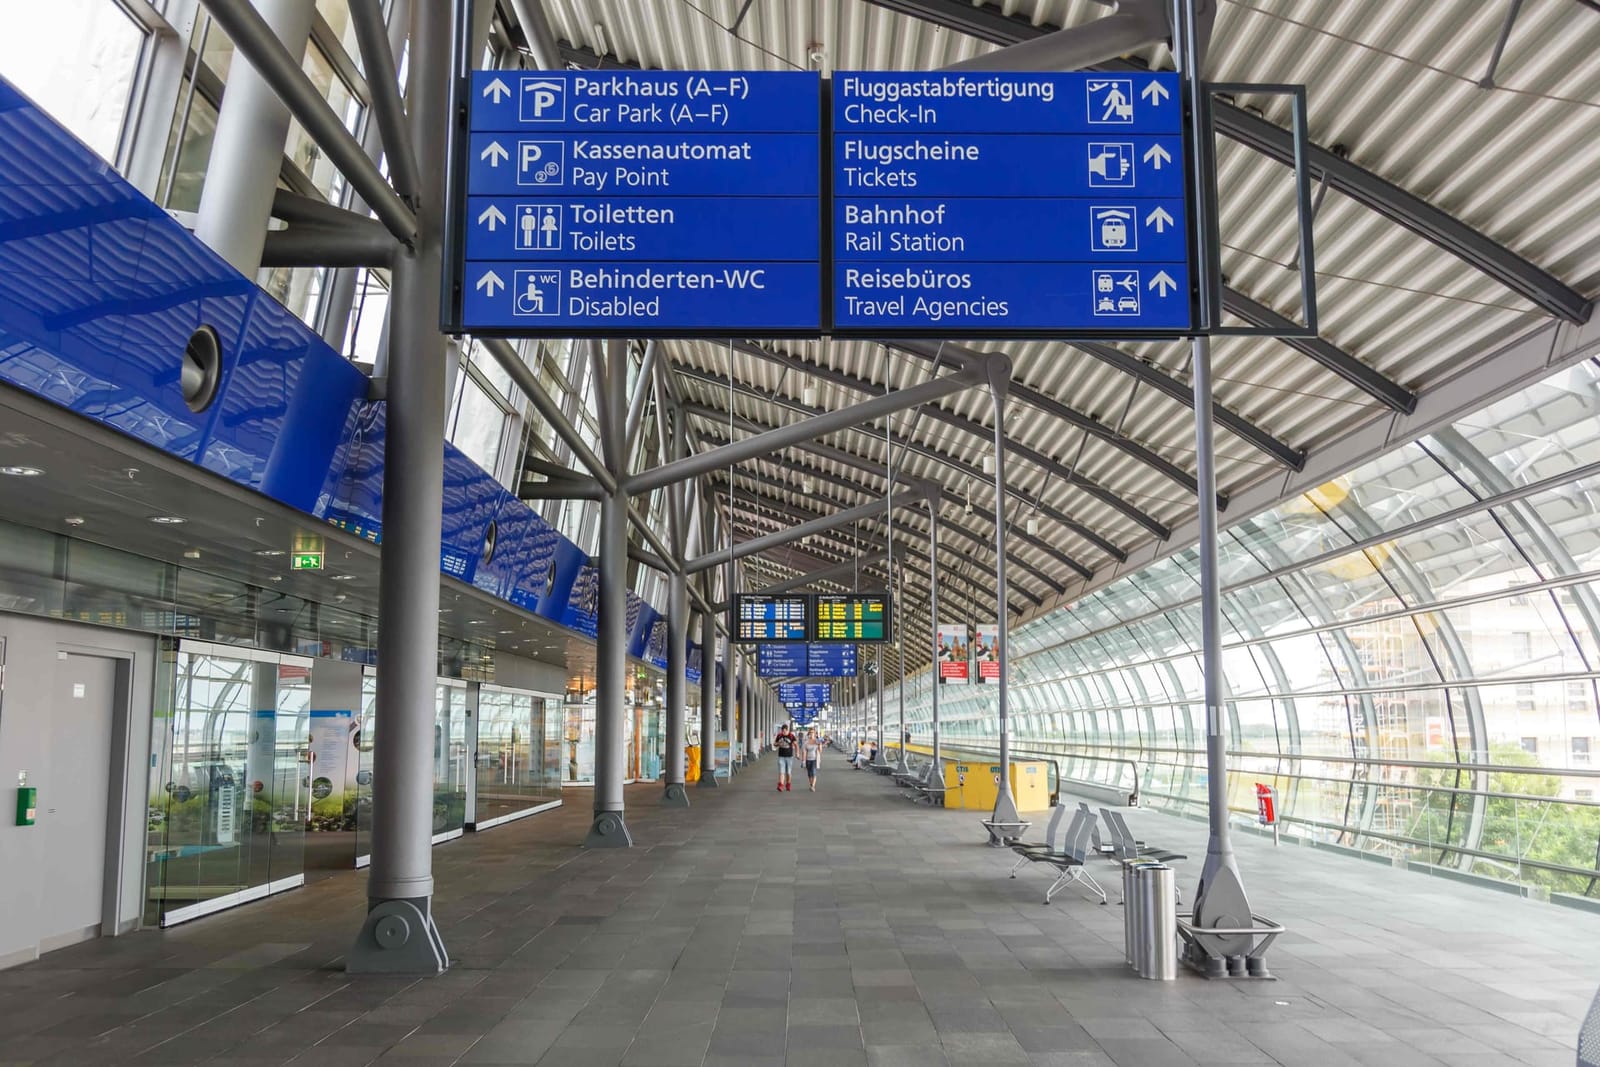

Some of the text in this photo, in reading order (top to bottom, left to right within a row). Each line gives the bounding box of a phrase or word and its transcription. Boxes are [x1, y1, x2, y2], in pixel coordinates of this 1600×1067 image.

[576, 77, 679, 97] Parkhaus
[844, 78, 1054, 102] Fluggastabfertigung
[574, 104, 611, 123] Car
[618, 104, 662, 123] Park
[844, 104, 936, 124] Check-In
[573, 141, 752, 160] Kassenautomat
[845, 140, 979, 165] Flugscheine
[573, 167, 669, 190] Pay Point
[844, 167, 917, 187] Tickets
[570, 204, 674, 224] Toiletten
[845, 205, 945, 225] Bahnhof
[569, 231, 636, 251] Toilets
[846, 232, 964, 252] Rail Station
[540, 275, 557, 284] WC
[570, 269, 765, 289] Behinderten-WC
[846, 268, 972, 289] Reisebüros
[569, 296, 659, 317] Disabled
[844, 296, 1009, 321] Travel Agencies
